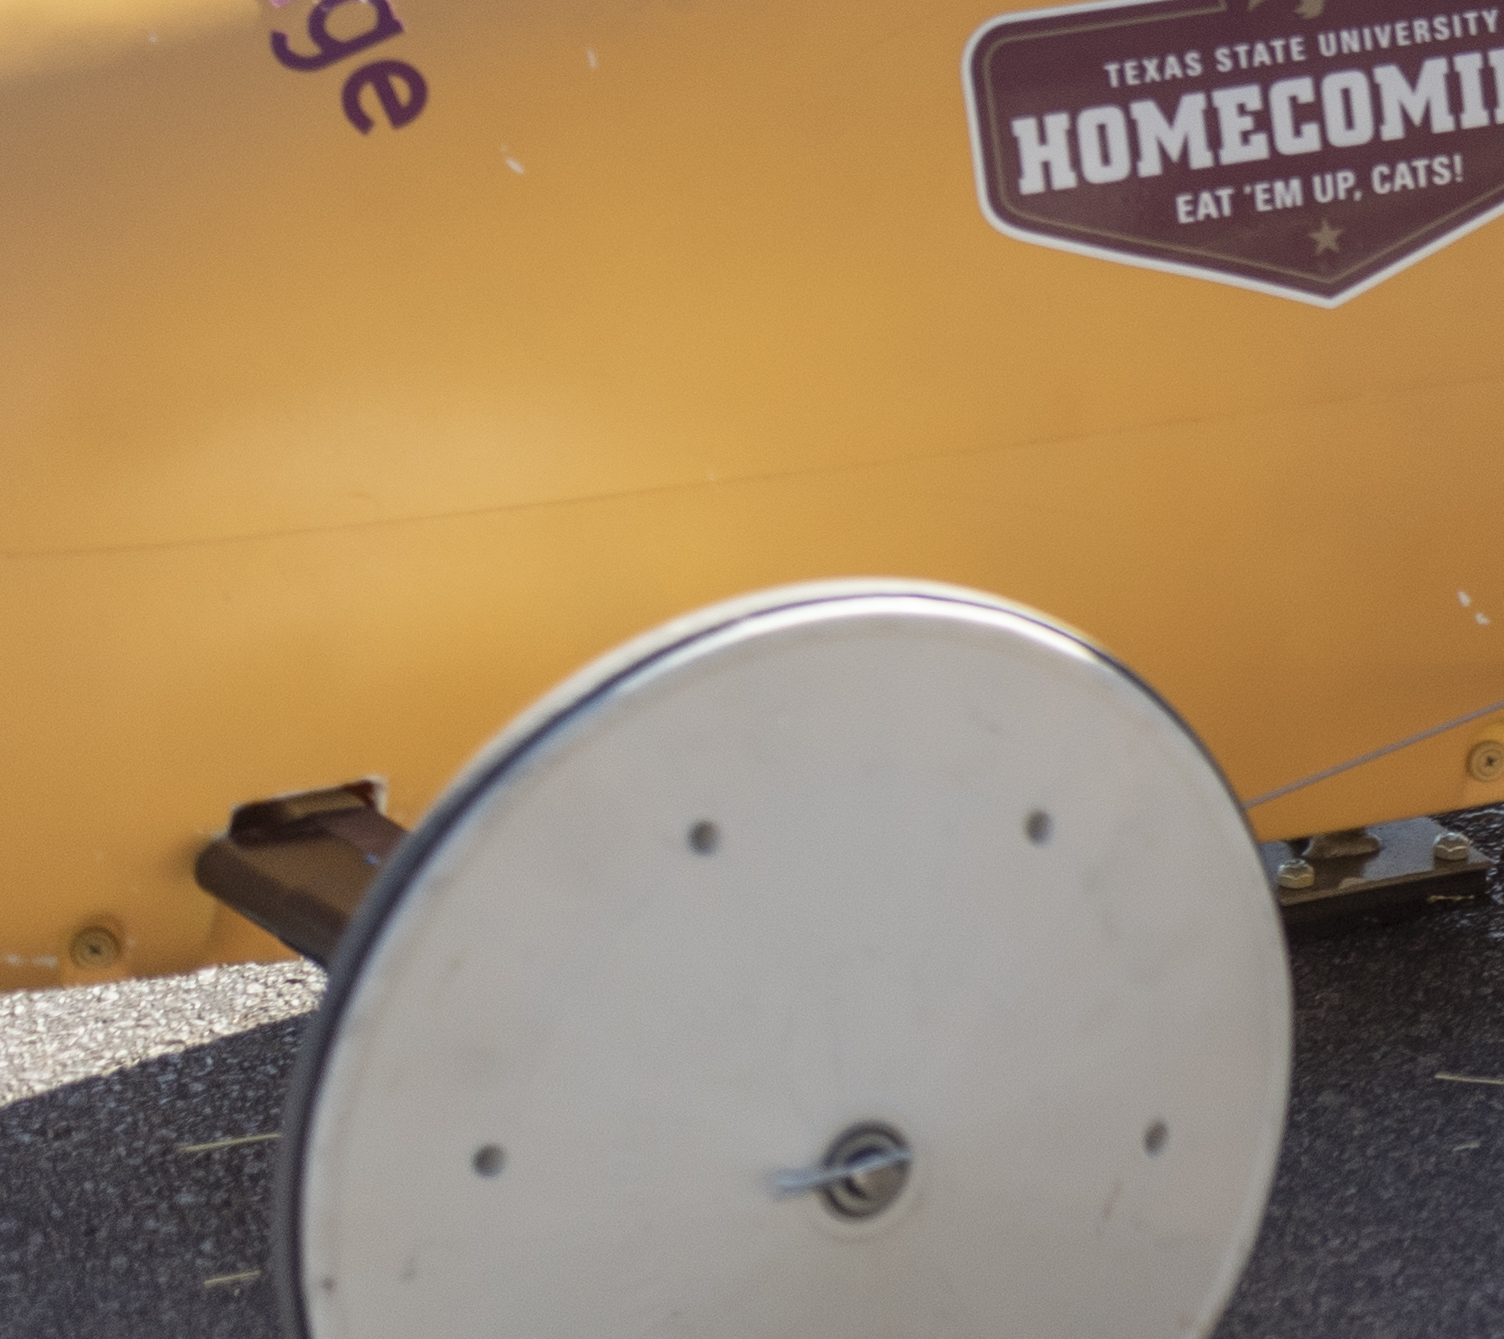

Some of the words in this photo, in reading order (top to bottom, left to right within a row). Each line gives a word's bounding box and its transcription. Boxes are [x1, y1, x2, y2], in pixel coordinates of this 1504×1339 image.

[1104, 48, 1203, 88] TEXAS
[1215, 36, 1306, 72] STATE
[1318, 8, 1500, 58] UNIVERSITY
[1175, 188, 1234, 224] EAT
[1243, 176, 1303, 213] 'EM
[1313, 165, 1363, 204] UP,
[1371, 154, 1465, 196] CATS!
